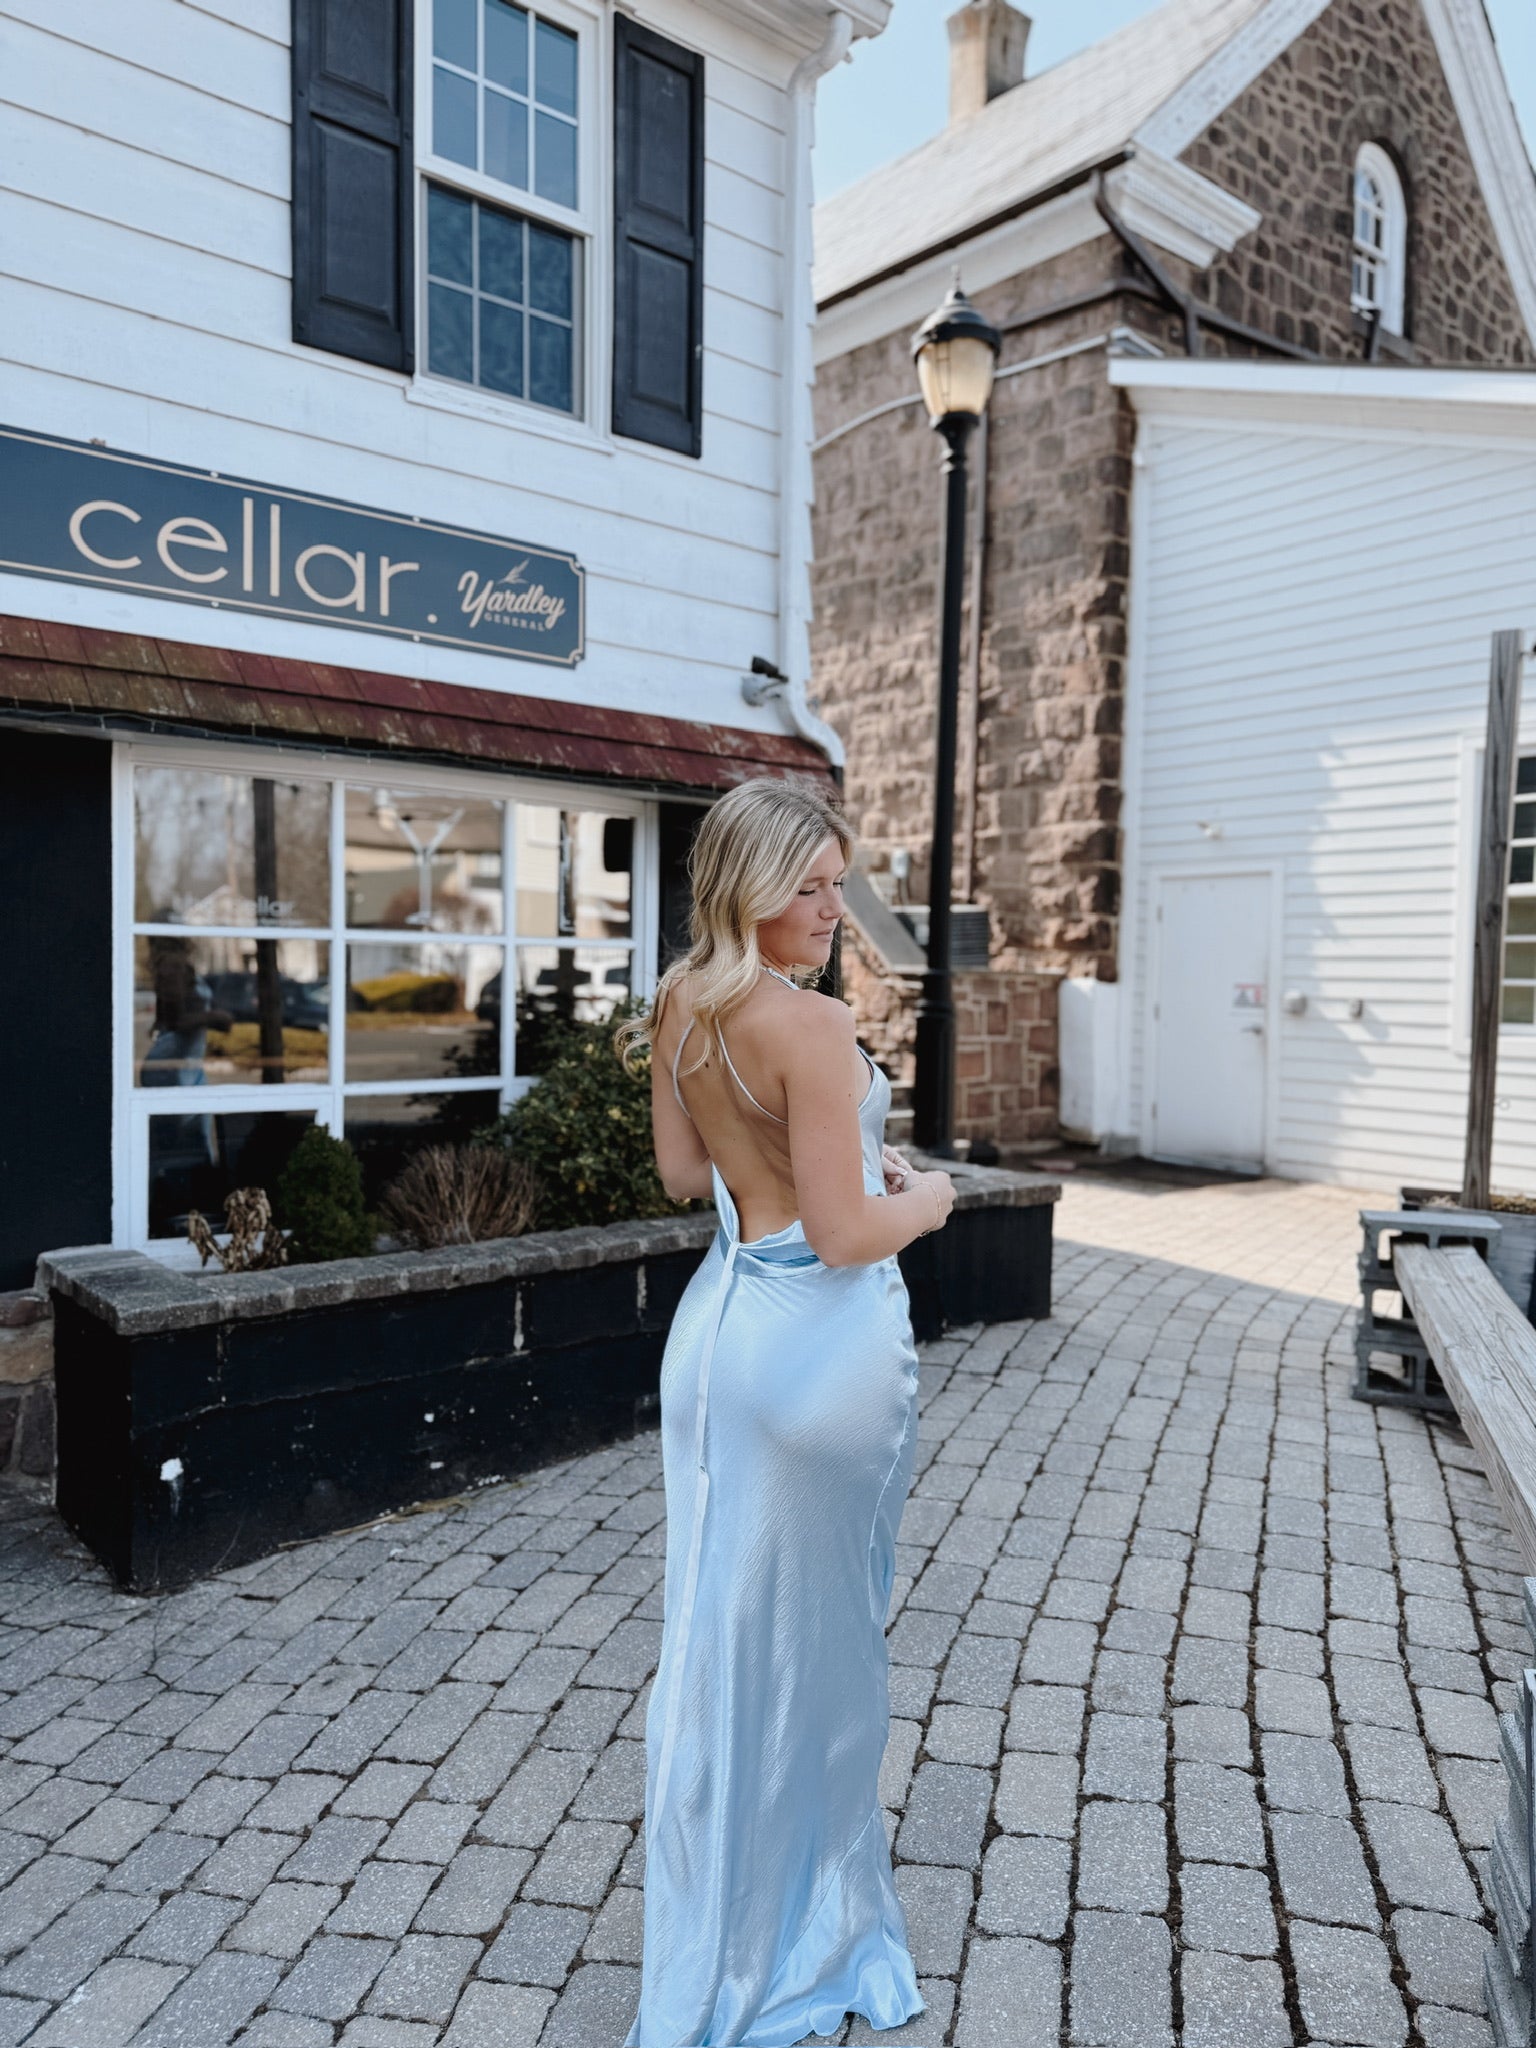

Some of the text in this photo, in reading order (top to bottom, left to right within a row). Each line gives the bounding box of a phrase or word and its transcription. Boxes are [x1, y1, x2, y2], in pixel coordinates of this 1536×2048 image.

[69, 498, 437, 623] cellar.
[457, 570, 566, 629] Yardley
[483, 612, 546, 632] GENERAL
